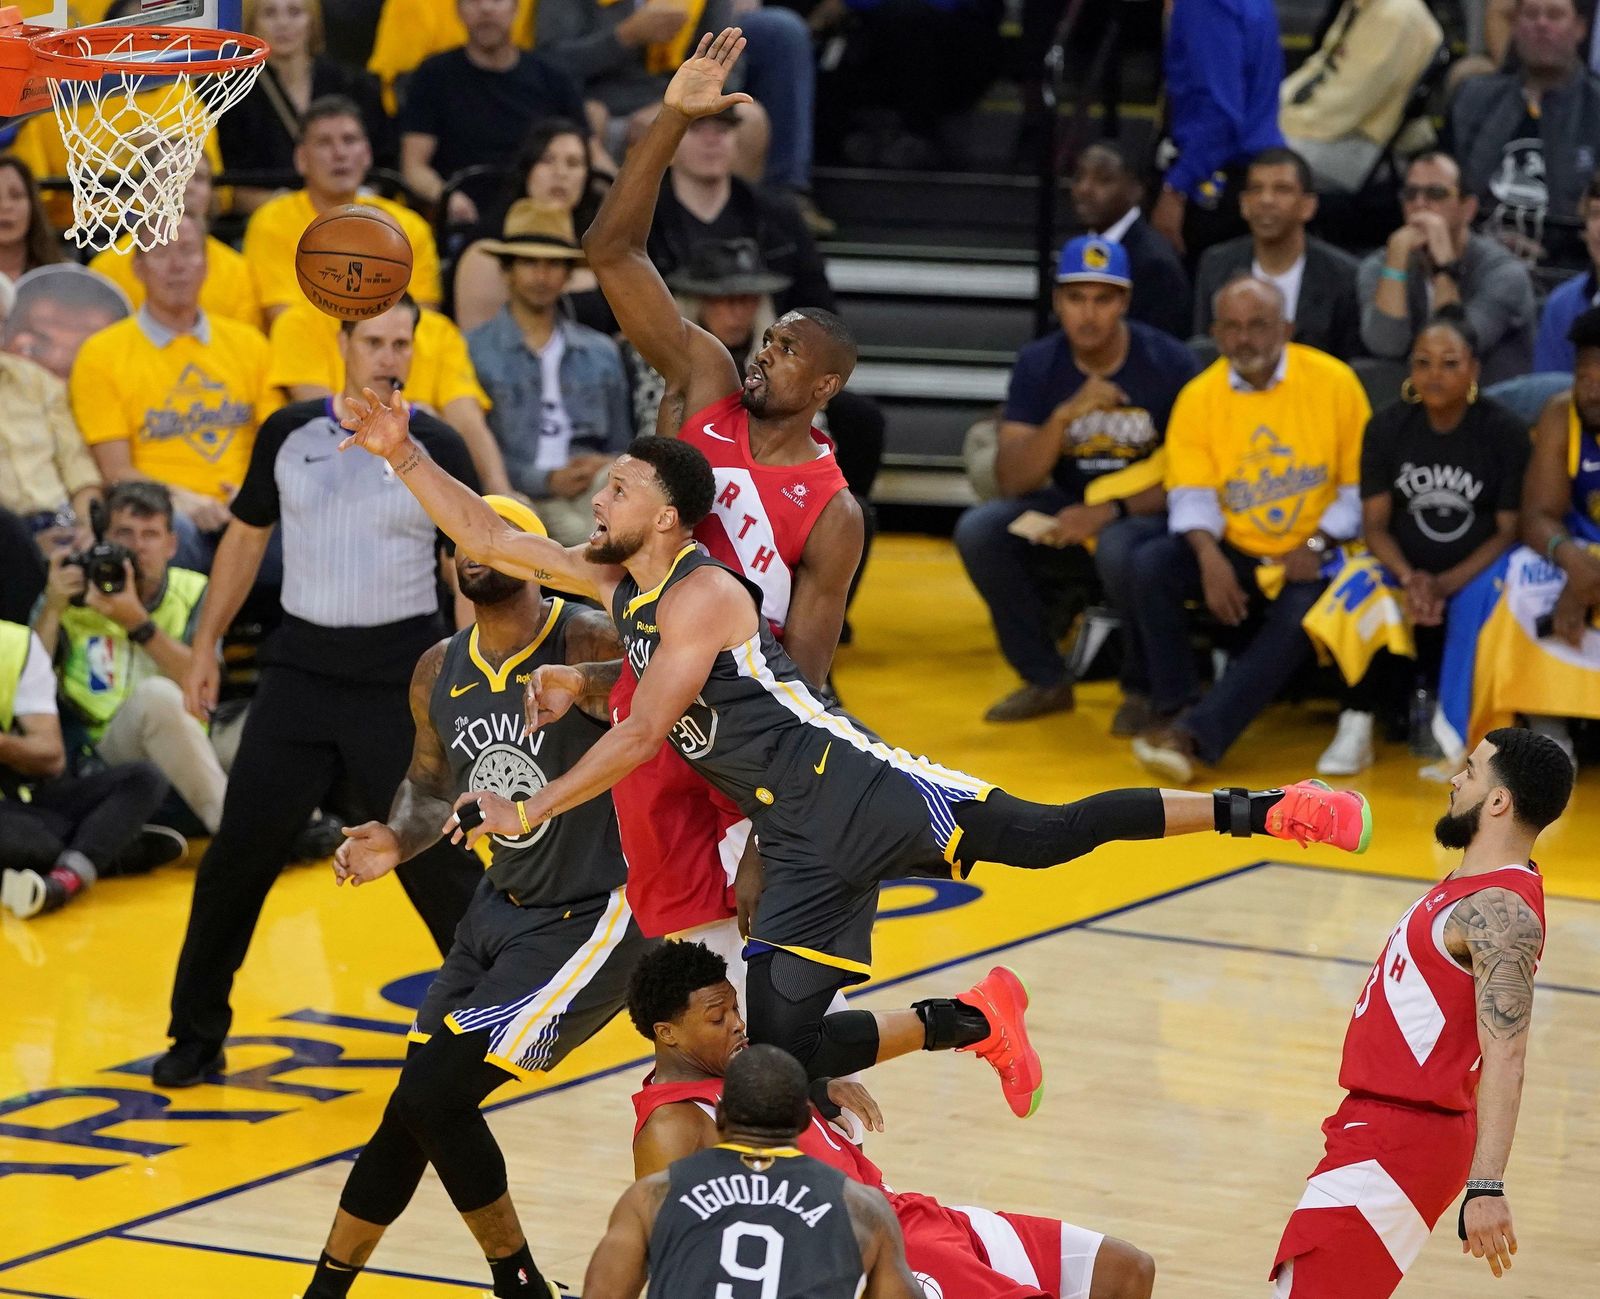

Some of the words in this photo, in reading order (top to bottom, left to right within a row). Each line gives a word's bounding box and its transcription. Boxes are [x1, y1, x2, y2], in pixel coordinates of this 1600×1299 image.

[780, 487, 793, 500] Sun
[792, 495, 805, 509] Life
[1394, 464, 1484, 501] TOWN
[717, 480, 776, 574] RTH
[515, 673, 533, 685] Rak
[450, 712, 545, 761] TOWN
[454, 715, 469, 732] The
[672, 715, 708, 754] 30
[678, 1173, 834, 1229] IGUODALA
[715, 1220, 785, 1299] 9
